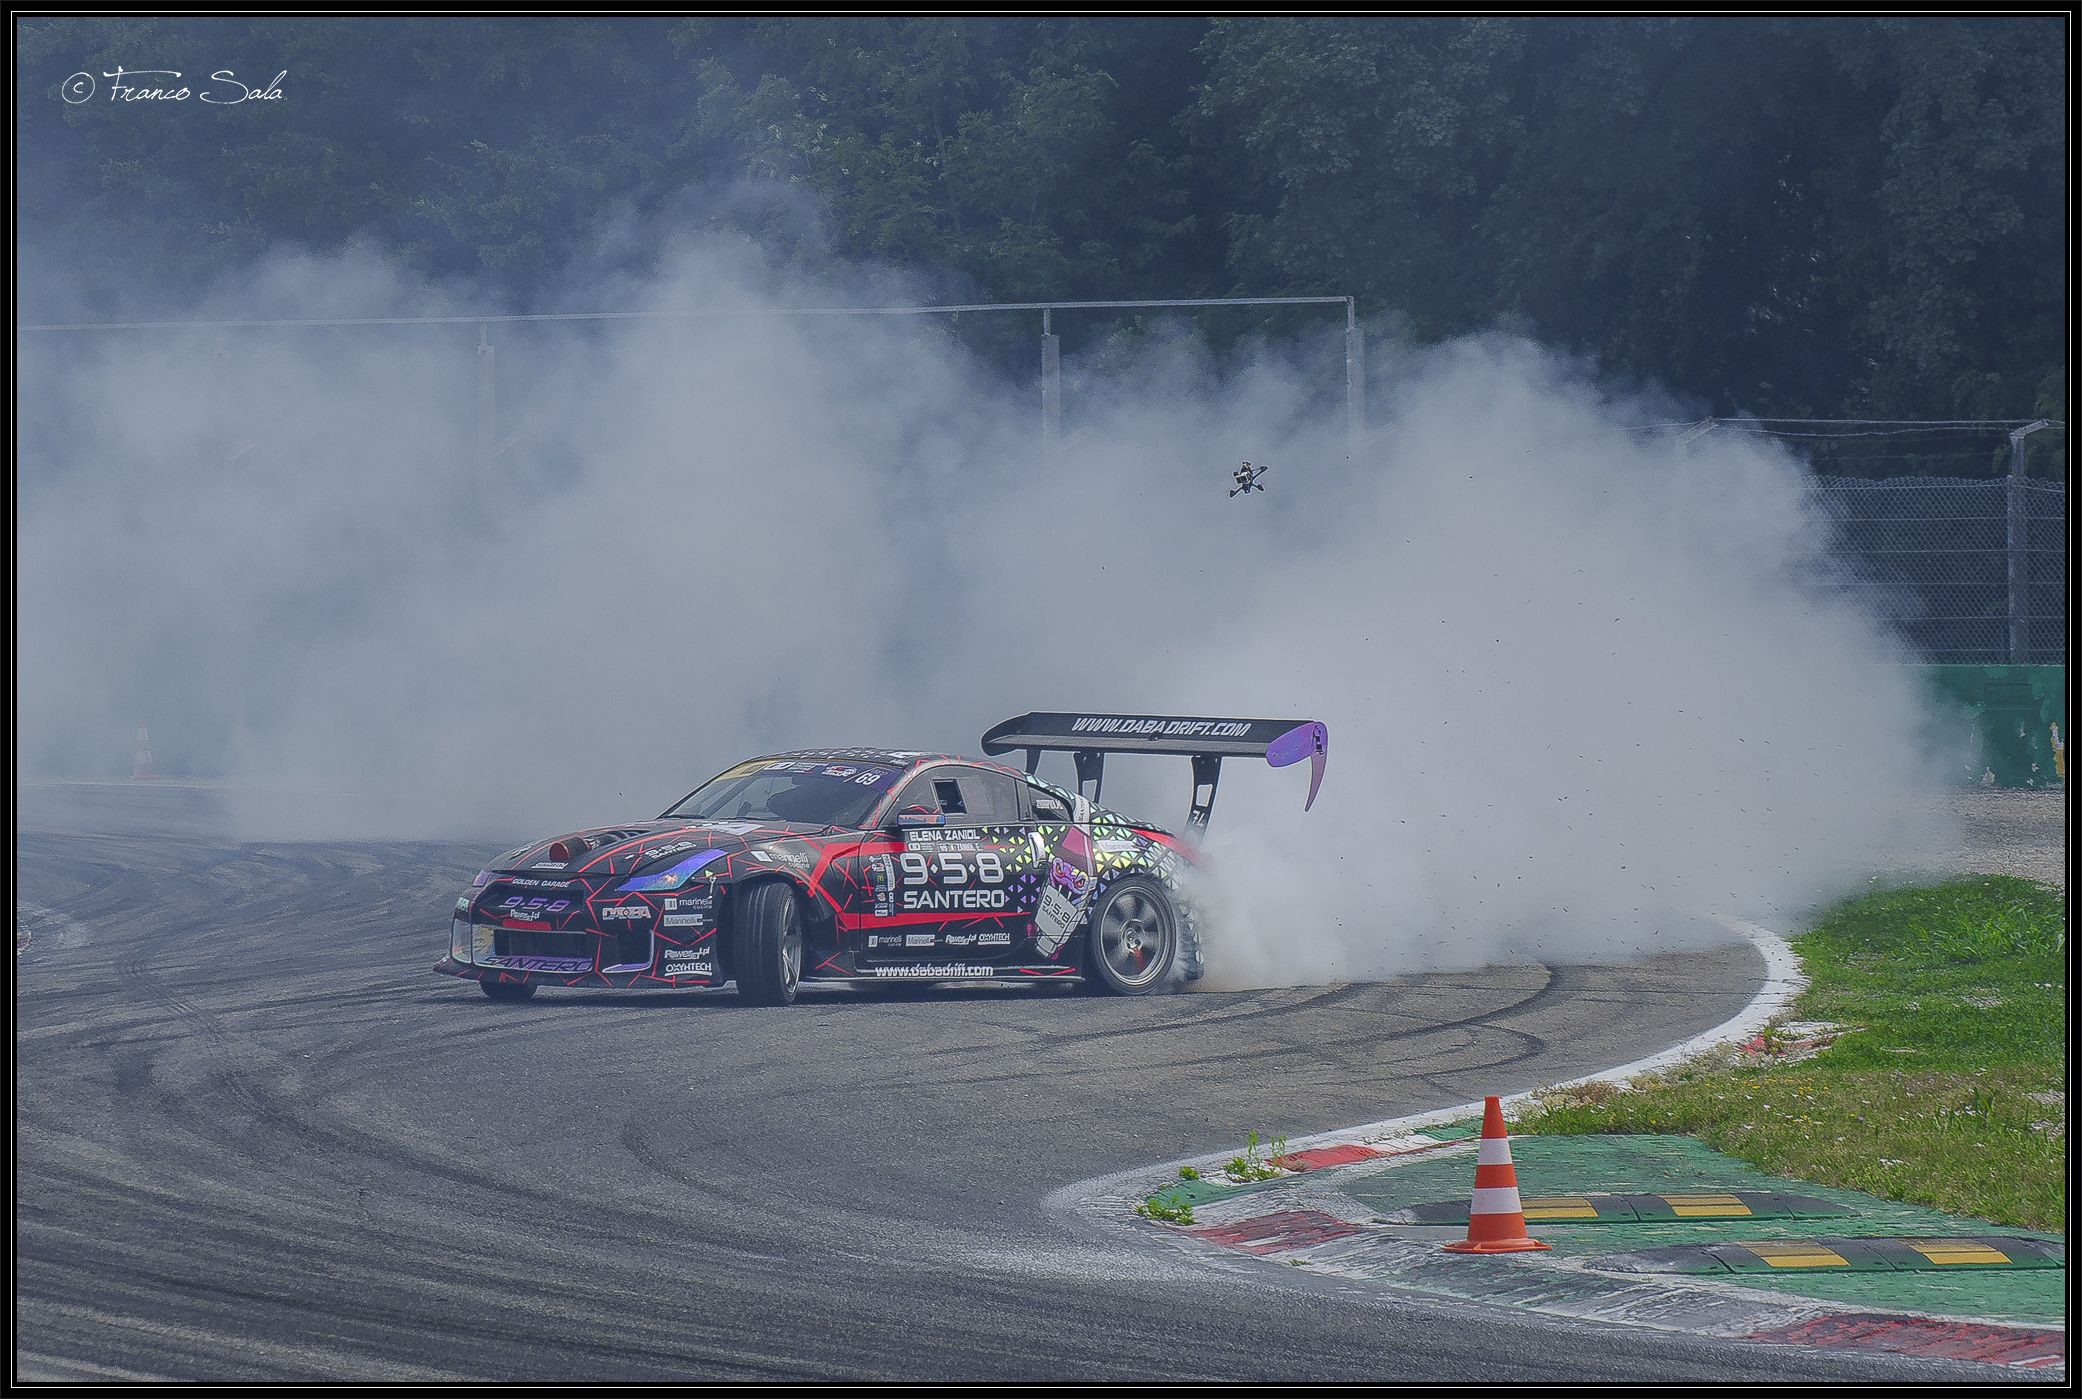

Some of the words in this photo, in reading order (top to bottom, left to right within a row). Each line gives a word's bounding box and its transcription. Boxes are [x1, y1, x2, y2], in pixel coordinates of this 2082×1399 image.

[1072, 717, 1252, 737] WWW.DABADRIFT.COM
[909, 830, 943, 842] ELENA
[511, 877, 540, 886] GOLDEN
[541, 879, 571, 888] GARAGE
[903, 889, 1005, 909] SANTERO
[478, 956, 593, 972] SANTERO
[875, 963, 993, 977] www.dabadrift.com
